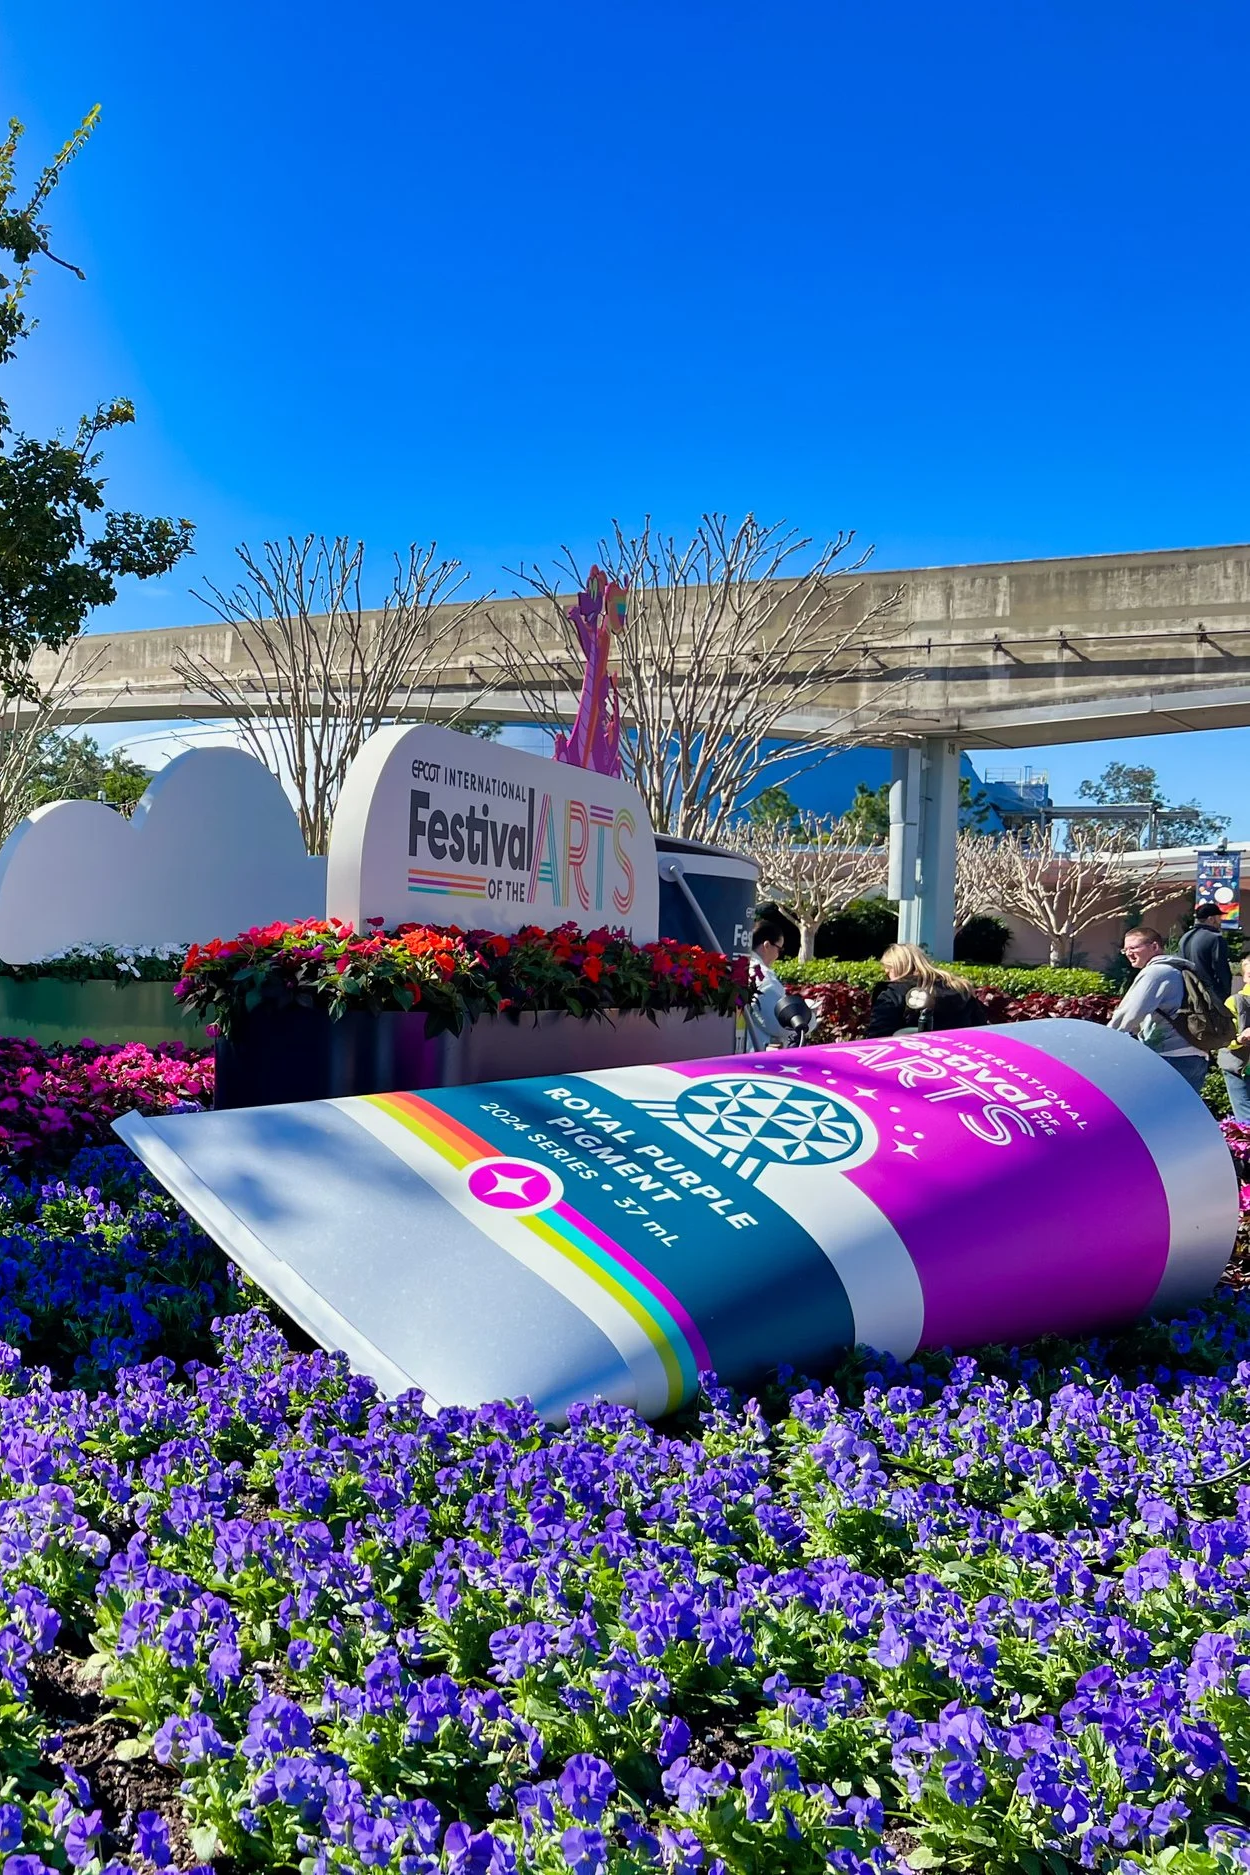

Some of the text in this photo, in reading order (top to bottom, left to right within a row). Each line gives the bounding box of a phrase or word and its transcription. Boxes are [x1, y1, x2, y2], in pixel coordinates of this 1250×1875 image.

[411, 759, 526, 803] EPCOT INTERNATIONAL
[408, 787, 636, 915] Festival ARTS
[488, 879, 525, 903] OF THE
[821, 1035, 1052, 1146] Festival ARTS
[953, 1041, 1088, 1131] INTERNATIONAL
[1029, 1110, 1061, 1136] OF THE
[479, 1102, 679, 1248] 2024 SERIES 37 mL
[543, 1087, 759, 1230] ROYAL PURPLE
[546, 1116, 682, 1202] PIGMENT
